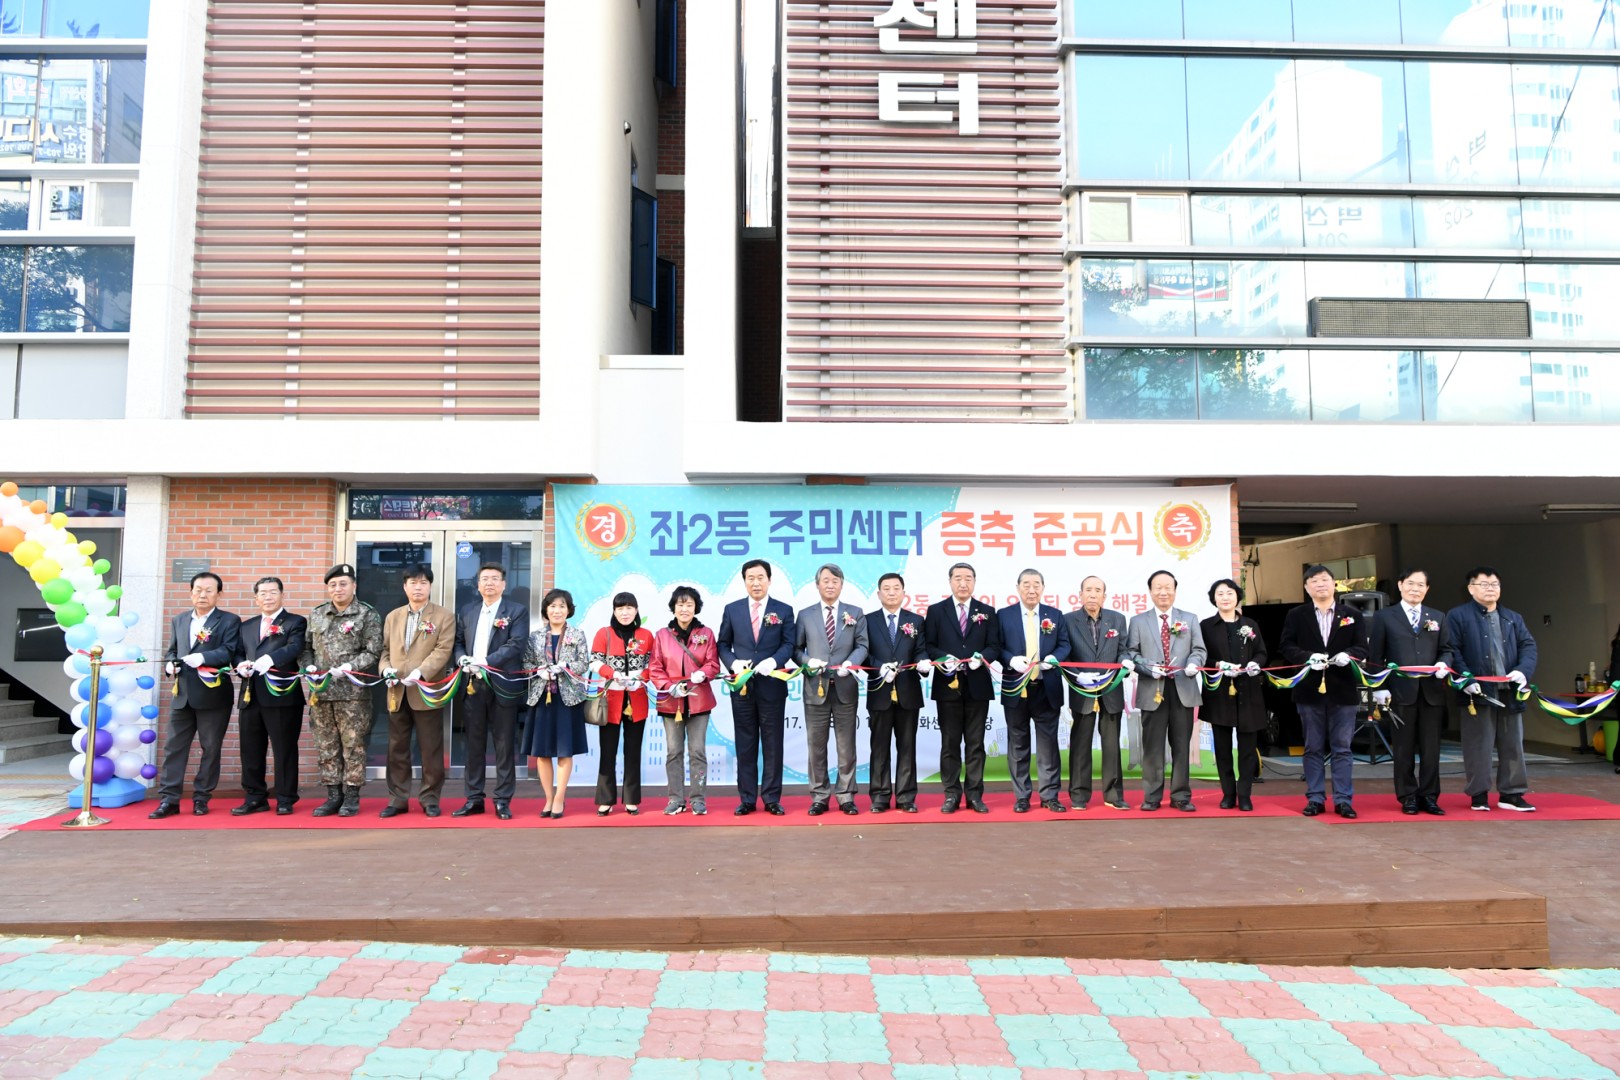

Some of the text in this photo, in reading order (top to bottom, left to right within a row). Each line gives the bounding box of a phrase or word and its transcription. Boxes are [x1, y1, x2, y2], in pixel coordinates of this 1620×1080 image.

[591, 511, 617, 543] 경
[650, 509, 1144, 557] 좌2동 주민센터 증축 준공식
[1167, 512, 1196, 543] 축
